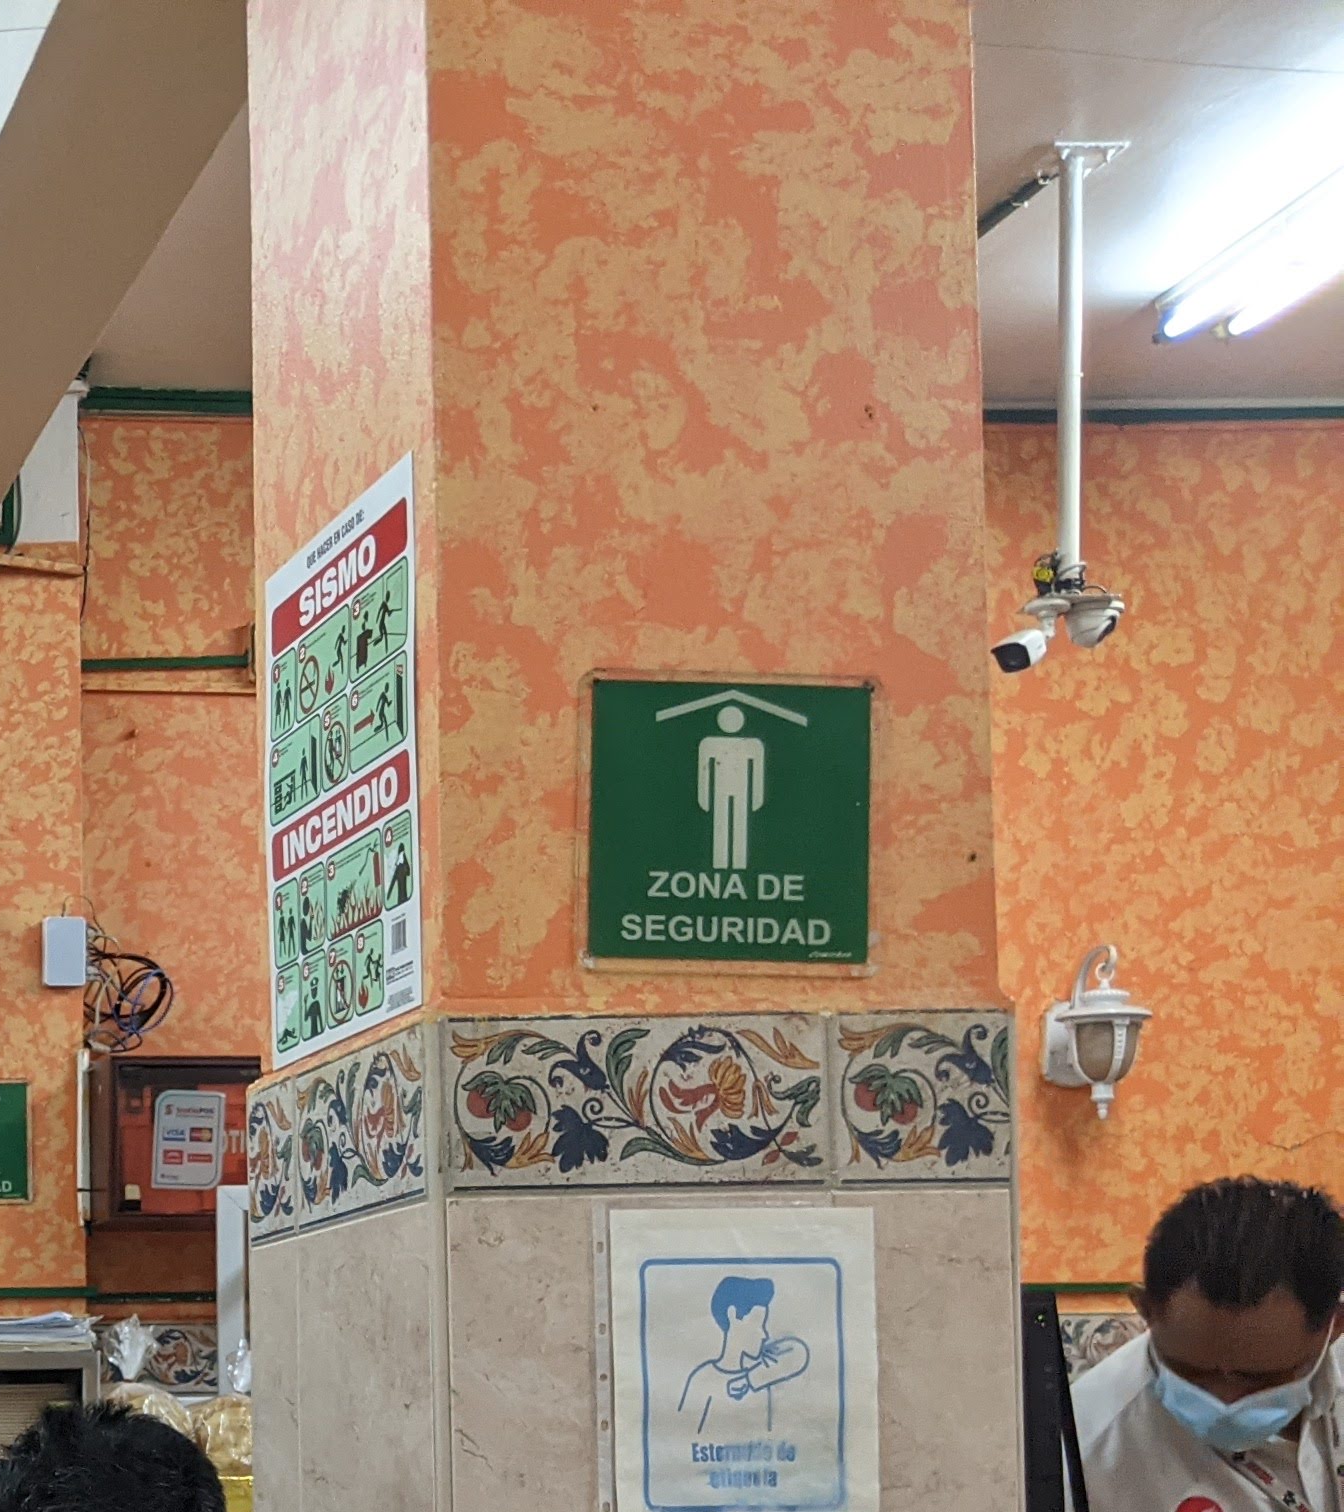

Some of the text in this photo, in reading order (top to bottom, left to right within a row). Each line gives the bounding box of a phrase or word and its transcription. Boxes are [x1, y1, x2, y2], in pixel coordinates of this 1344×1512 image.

[341, 516, 354, 538] CASO
[299, 534, 376, 627] SISMO
[282, 766, 398, 870] INCENDIO
[647, 871, 805, 901] ZONA DE
[620, 913, 831, 945] SEGURIDAD
